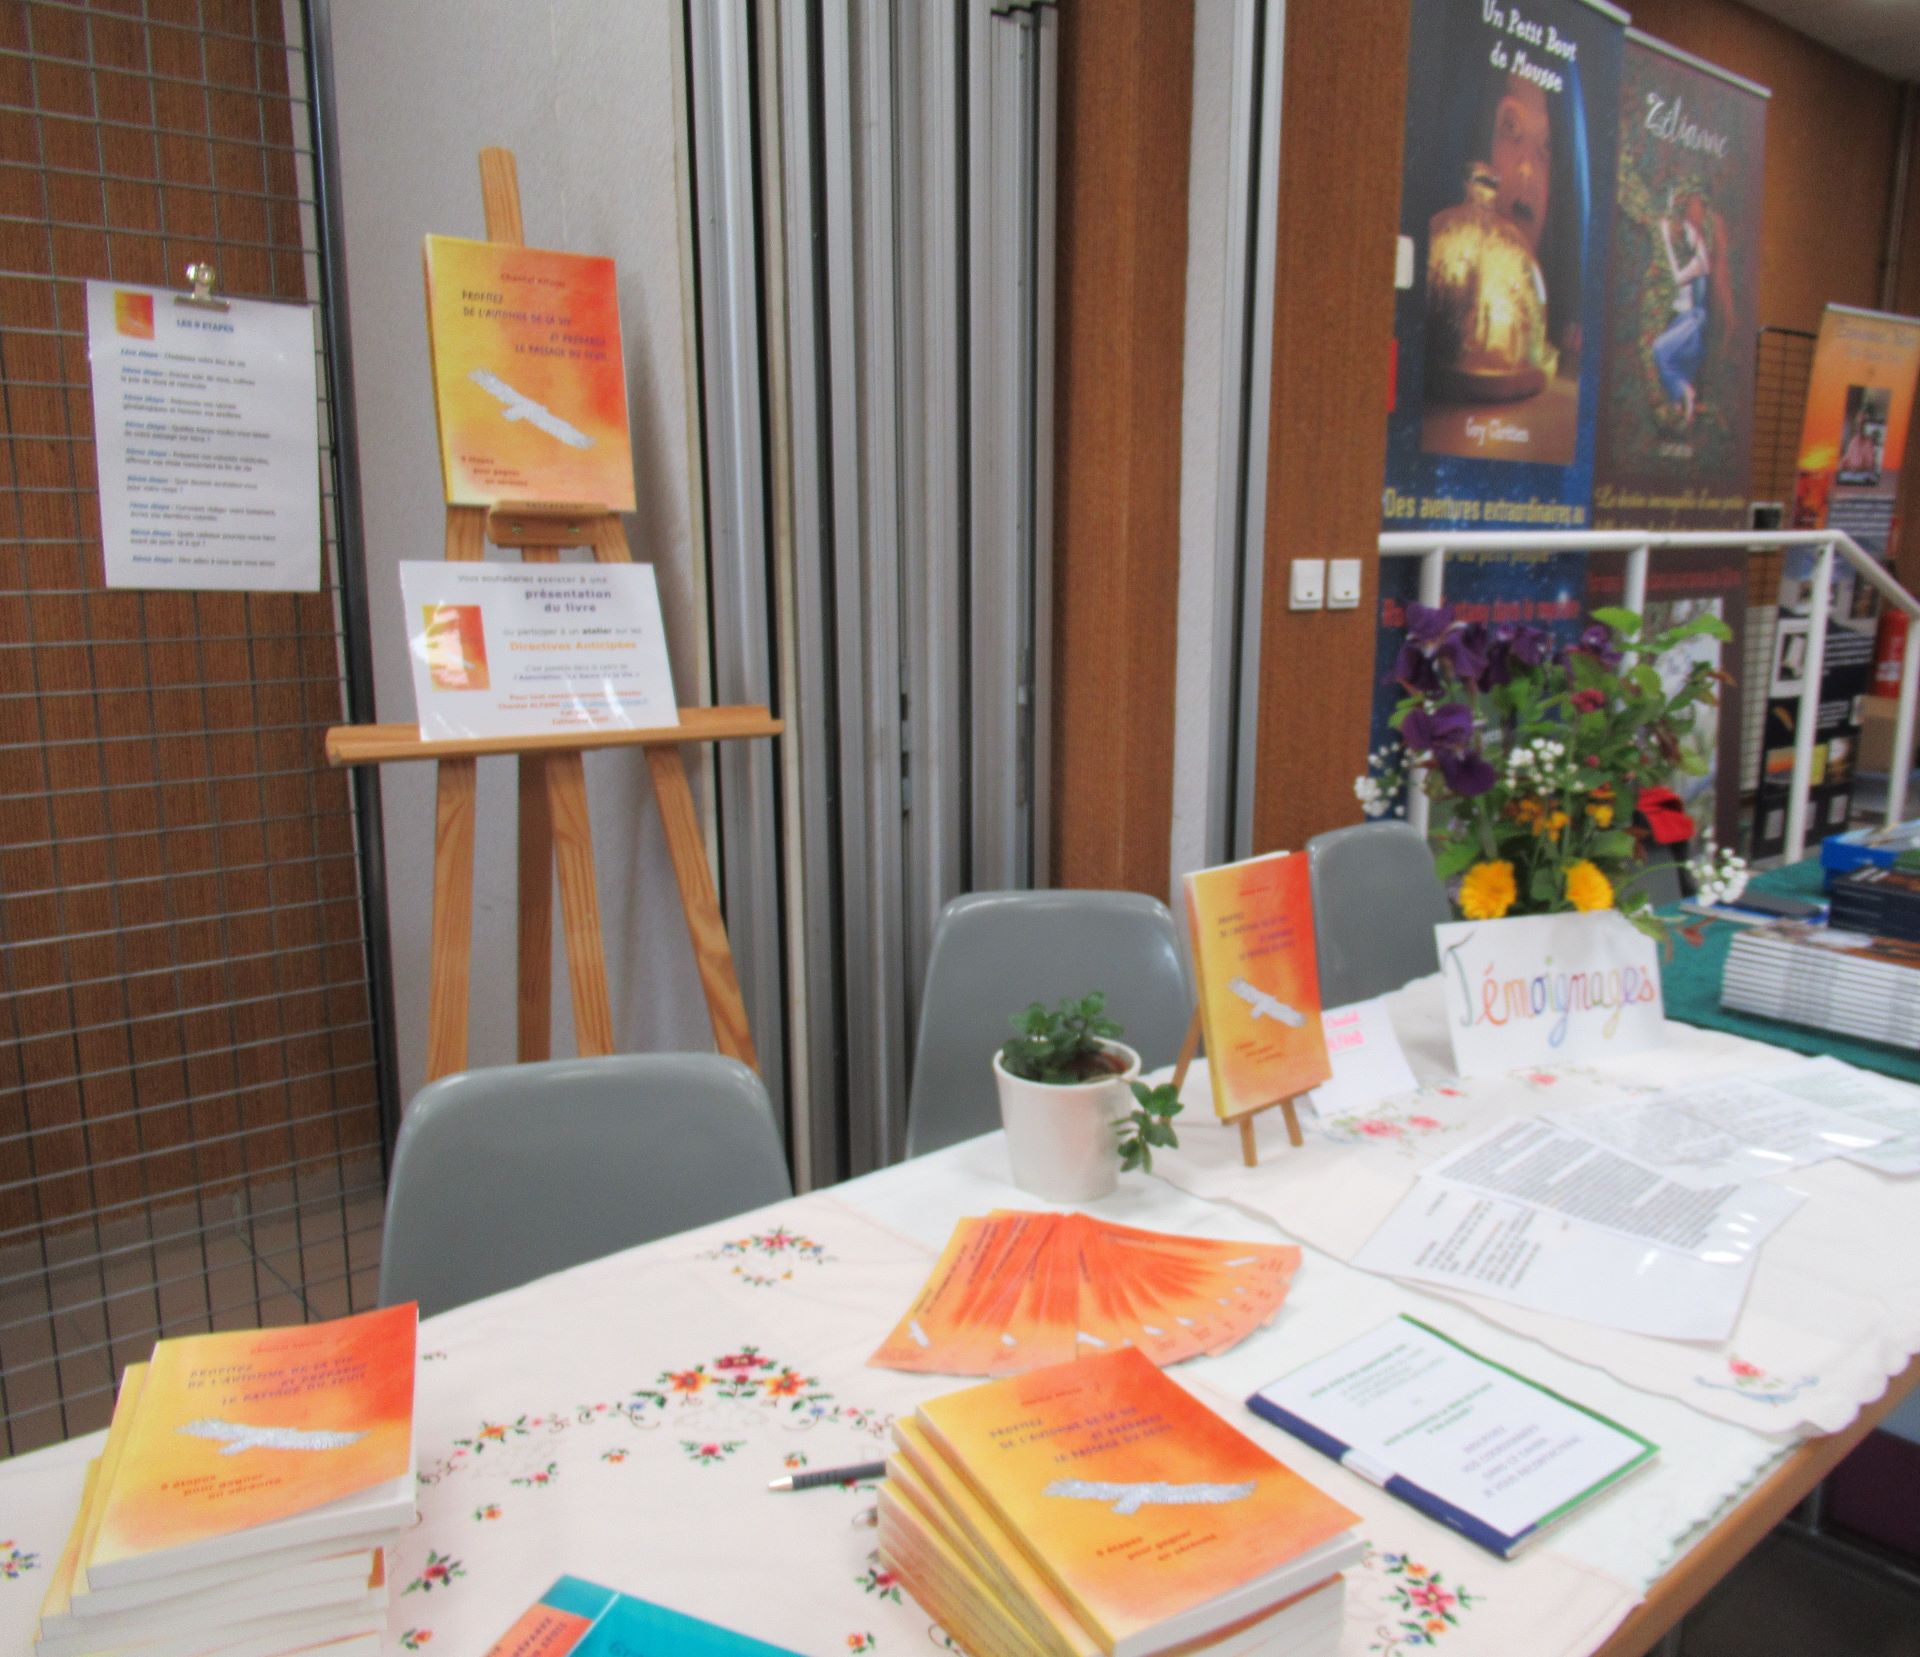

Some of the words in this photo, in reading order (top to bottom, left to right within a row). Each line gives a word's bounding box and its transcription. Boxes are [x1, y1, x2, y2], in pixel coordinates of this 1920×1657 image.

[1507, 8, 1543, 46] Petit
[1545, 25, 1577, 61] Bout
[1490, 41, 1507, 69] de
[1510, 50, 1563, 92] Mousse
[1383, 488, 1416, 519] Des
[1420, 496, 1480, 521] aventures
[1484, 496, 1572, 524] extraordinaires
[524, 587, 613, 601] présentation
[544, 602, 560, 613] du
[566, 602, 597, 613] livre
[582, 626, 613, 636] atelier
[1443, 930, 1657, 1048] Témoignages
